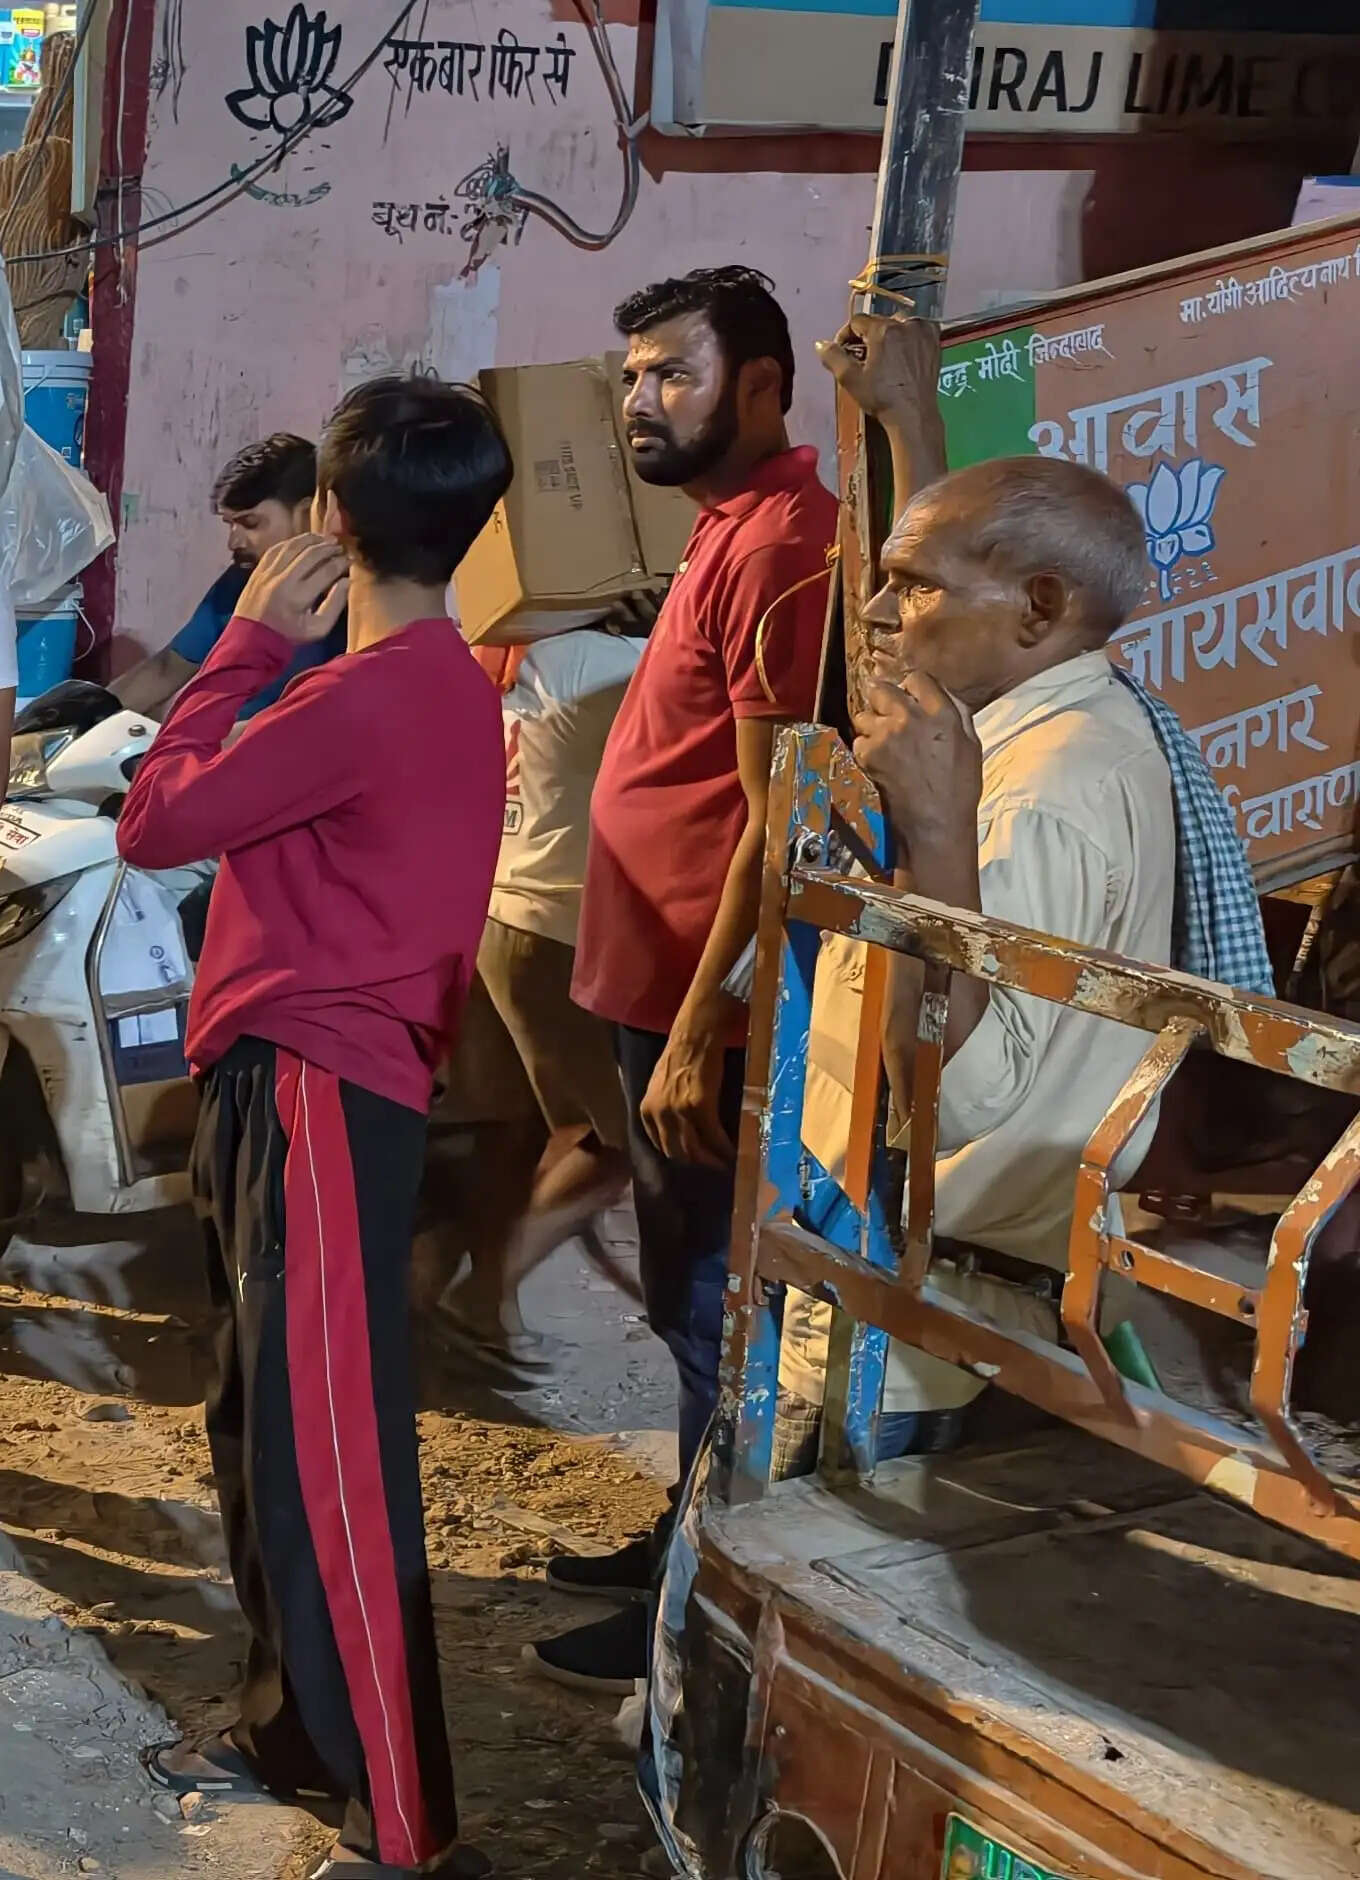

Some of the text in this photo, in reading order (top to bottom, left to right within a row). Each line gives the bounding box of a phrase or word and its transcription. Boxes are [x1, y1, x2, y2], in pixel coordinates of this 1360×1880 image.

[488, 28, 540, 106] फिर
[542, 32, 576, 106] से
[873, 41, 1103, 114] IRAJ
[1124, 53, 1287, 117] LIME
[1206, 276, 1243, 315] योगी
[974, 339, 1026, 382] मोदी
[1027, 356, 1275, 476] आवास
